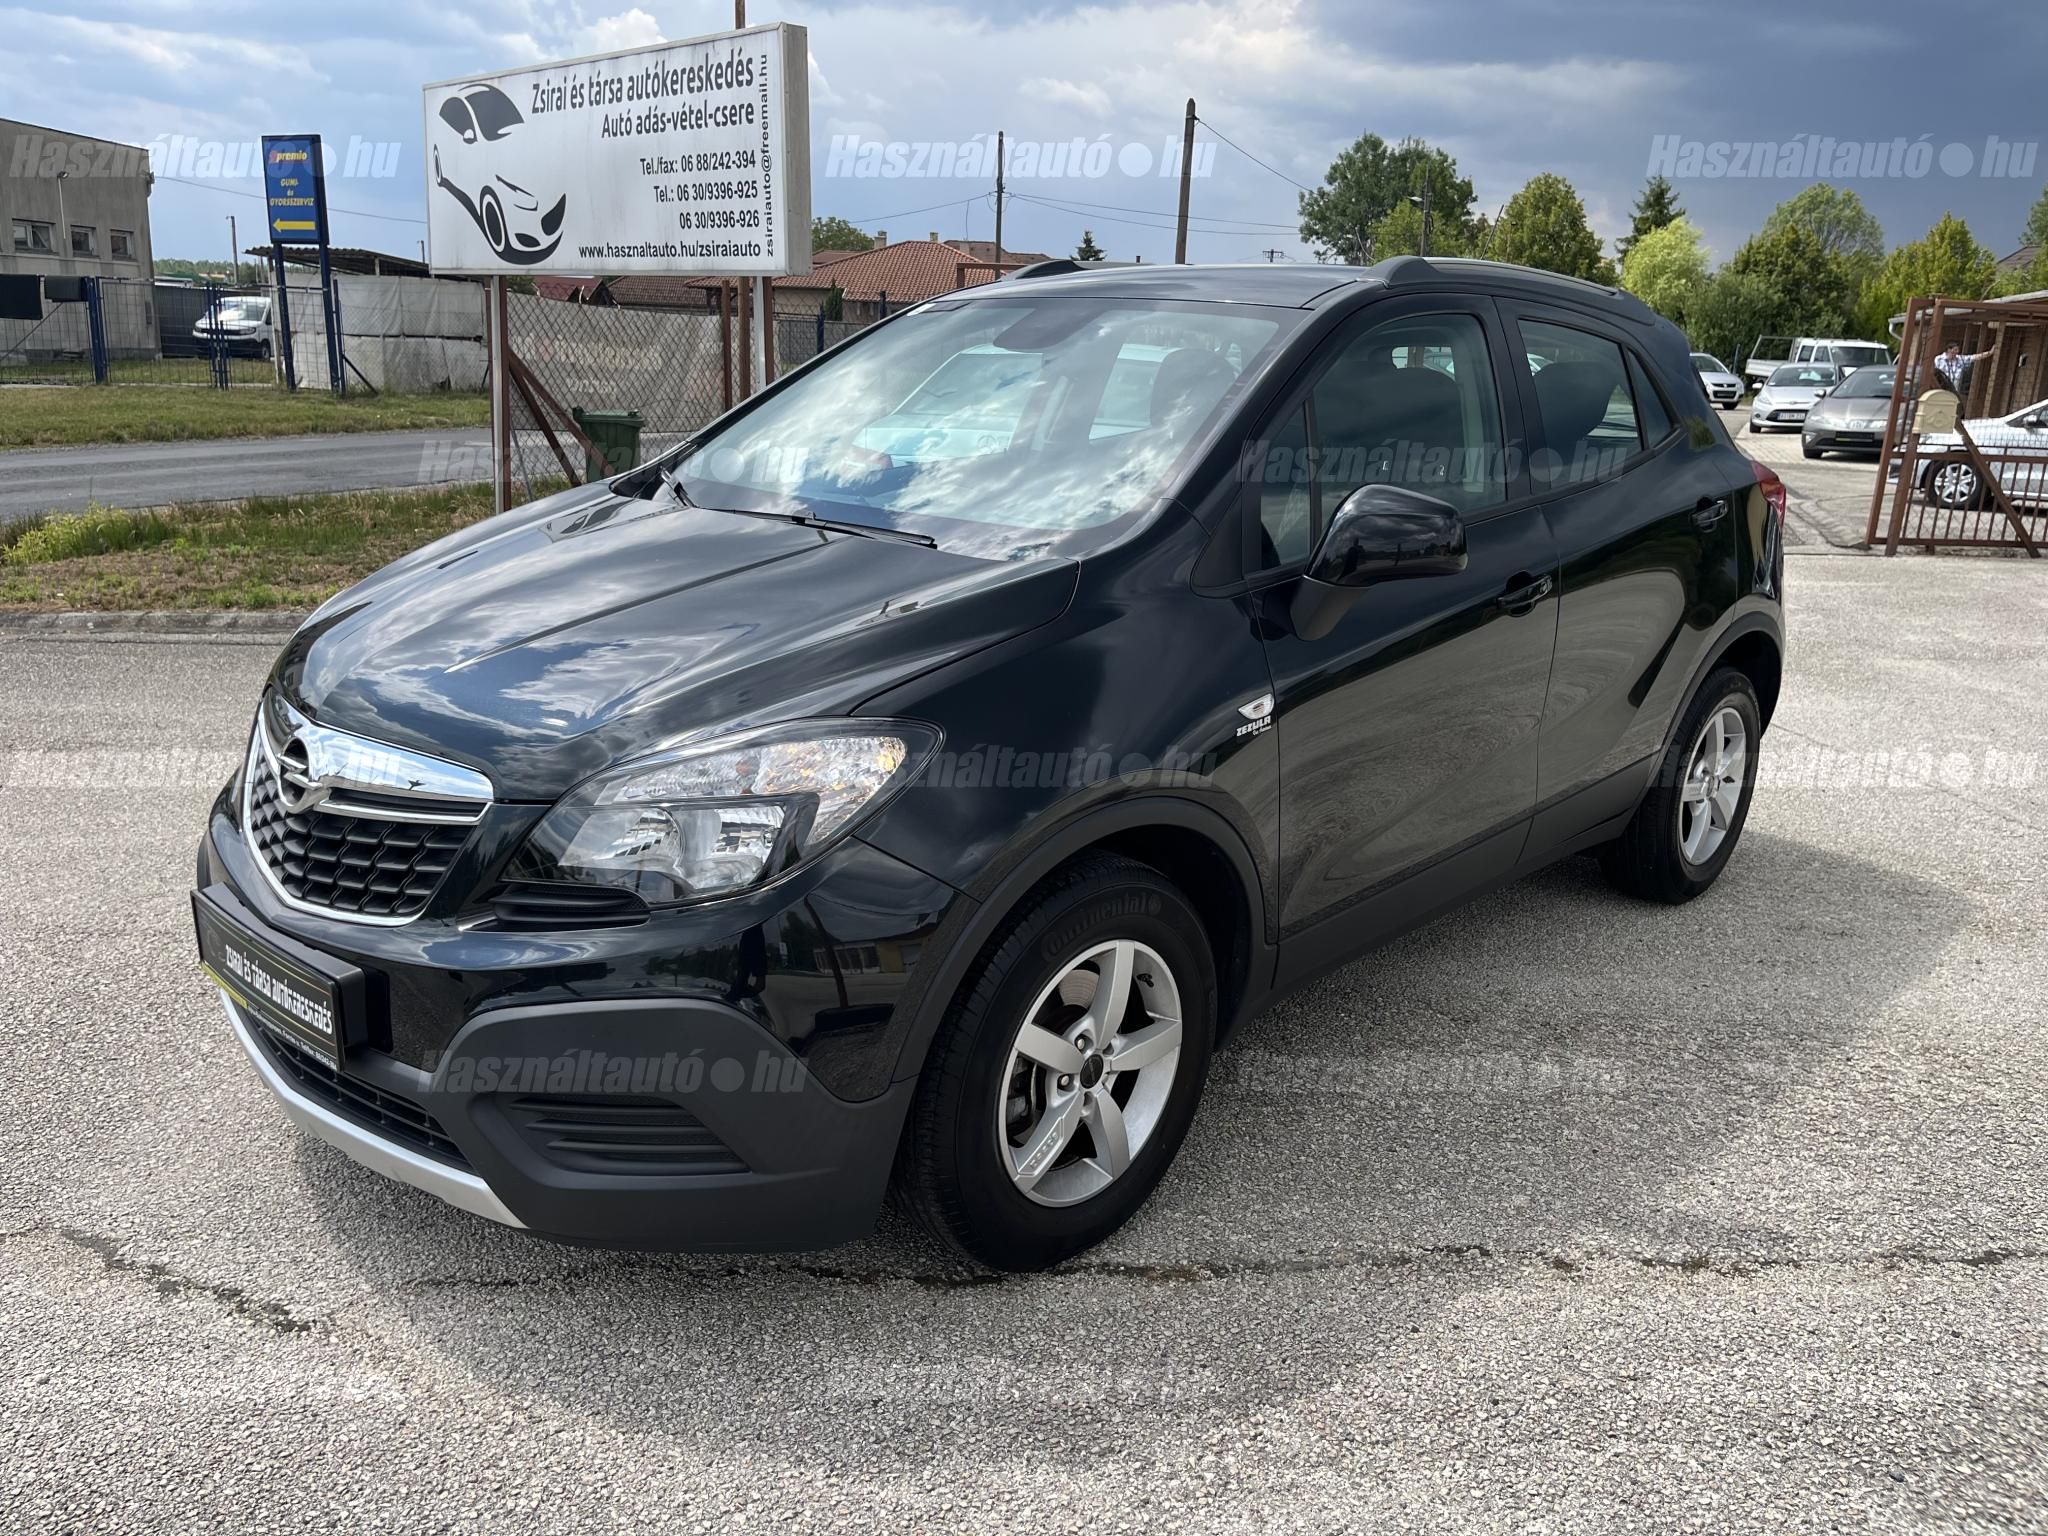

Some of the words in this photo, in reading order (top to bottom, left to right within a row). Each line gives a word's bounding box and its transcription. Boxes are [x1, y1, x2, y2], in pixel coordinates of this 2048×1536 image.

[531, 76, 567, 114] Zsirai
[570, 73, 585, 109] és
[588, 69, 623, 107] társa
[626, 47, 754, 102] autókereskedés
[601, 109, 633, 138] Autó
[636, 99, 755, 134] adás-vétel-csere
[277, 150, 308, 163] premio
[640, 156, 678, 175] Tel./fax:
[681, 155, 694, 172] 06
[696, 150, 756, 171] 88/242-394
[758, 54, 774, 257] zsiraiauto@freemail.hu
[653, 185, 674, 203] Tel.:
[676, 184, 690, 202] 06
[692, 180, 758, 201] 30/9396-925
[679, 212, 692, 229] 06
[694, 209, 760, 229] 30/9396-926
[578, 240, 761, 259] www.hasznaltauto.hu/zsiraiauto
[1236, 715, 1271, 737] ZEZULA
